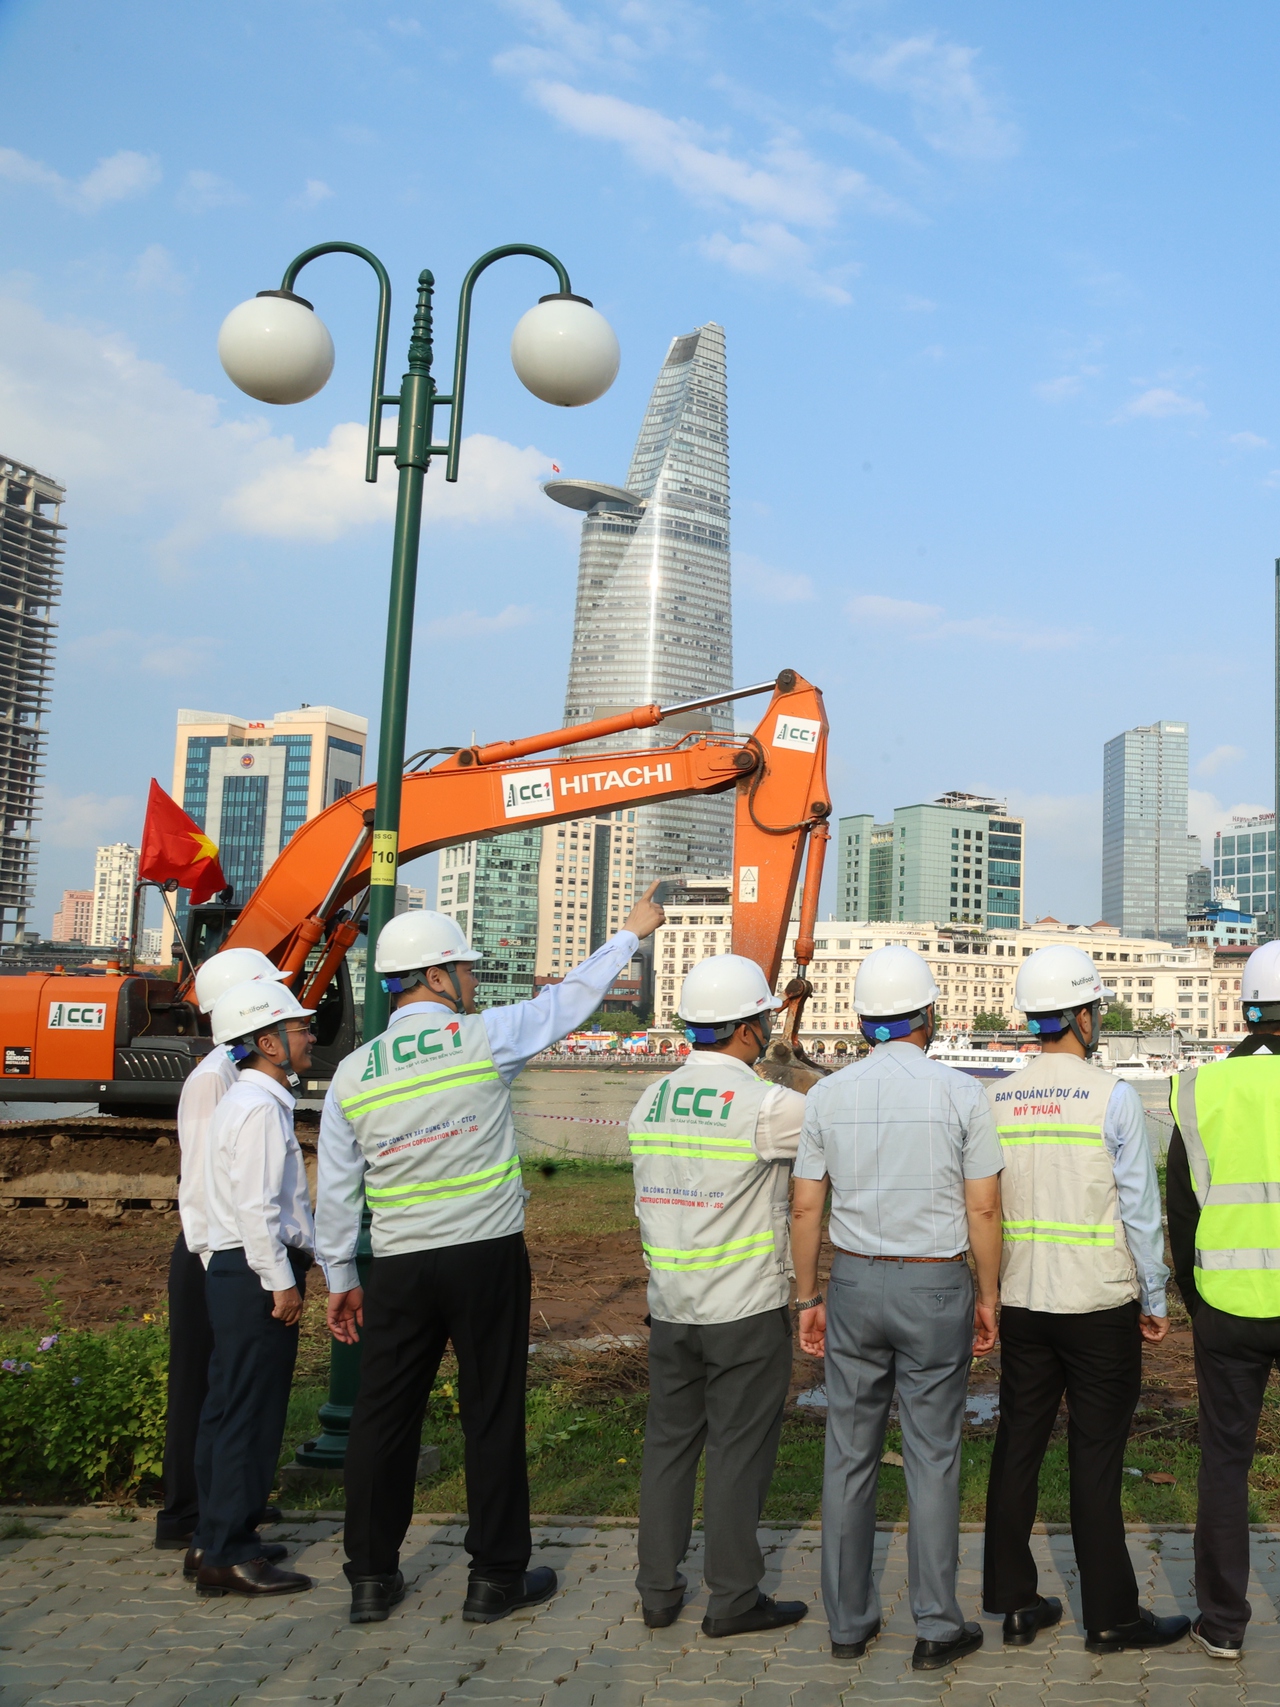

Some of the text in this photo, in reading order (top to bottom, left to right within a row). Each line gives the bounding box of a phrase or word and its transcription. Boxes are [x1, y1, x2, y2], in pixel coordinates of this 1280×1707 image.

[559, 762, 673, 796] HITACHI
[1258, 812, 1276, 821] SUNW
[372, 851, 395, 864] T10
[1071, 974, 1095, 988] Nutifood
[67, 1007, 104, 1024] CC1
[239, 1002, 270, 1017] Nutifood
[391, 1022, 462, 1064] CC1
[994, 1086, 1090, 1102] BAN QUẢN LÝ DỰ ÁN
[671, 1086, 736, 1120] CC1
[1013, 1102, 1061, 1117] MỸ THUẬN
[388, 1135, 405, 1145] CÔNG
[442, 1119, 451, 1129] SỐ
[461, 1115, 477, 1124] CTCP
[450, 1128, 463, 1137] NO.1
[468, 1125, 479, 1133] JSC
[649, 1186, 665, 1194] CÔNG
[690, 1188, 698, 1197] SỐ
[696, 1200, 709, 1208] NO.1
